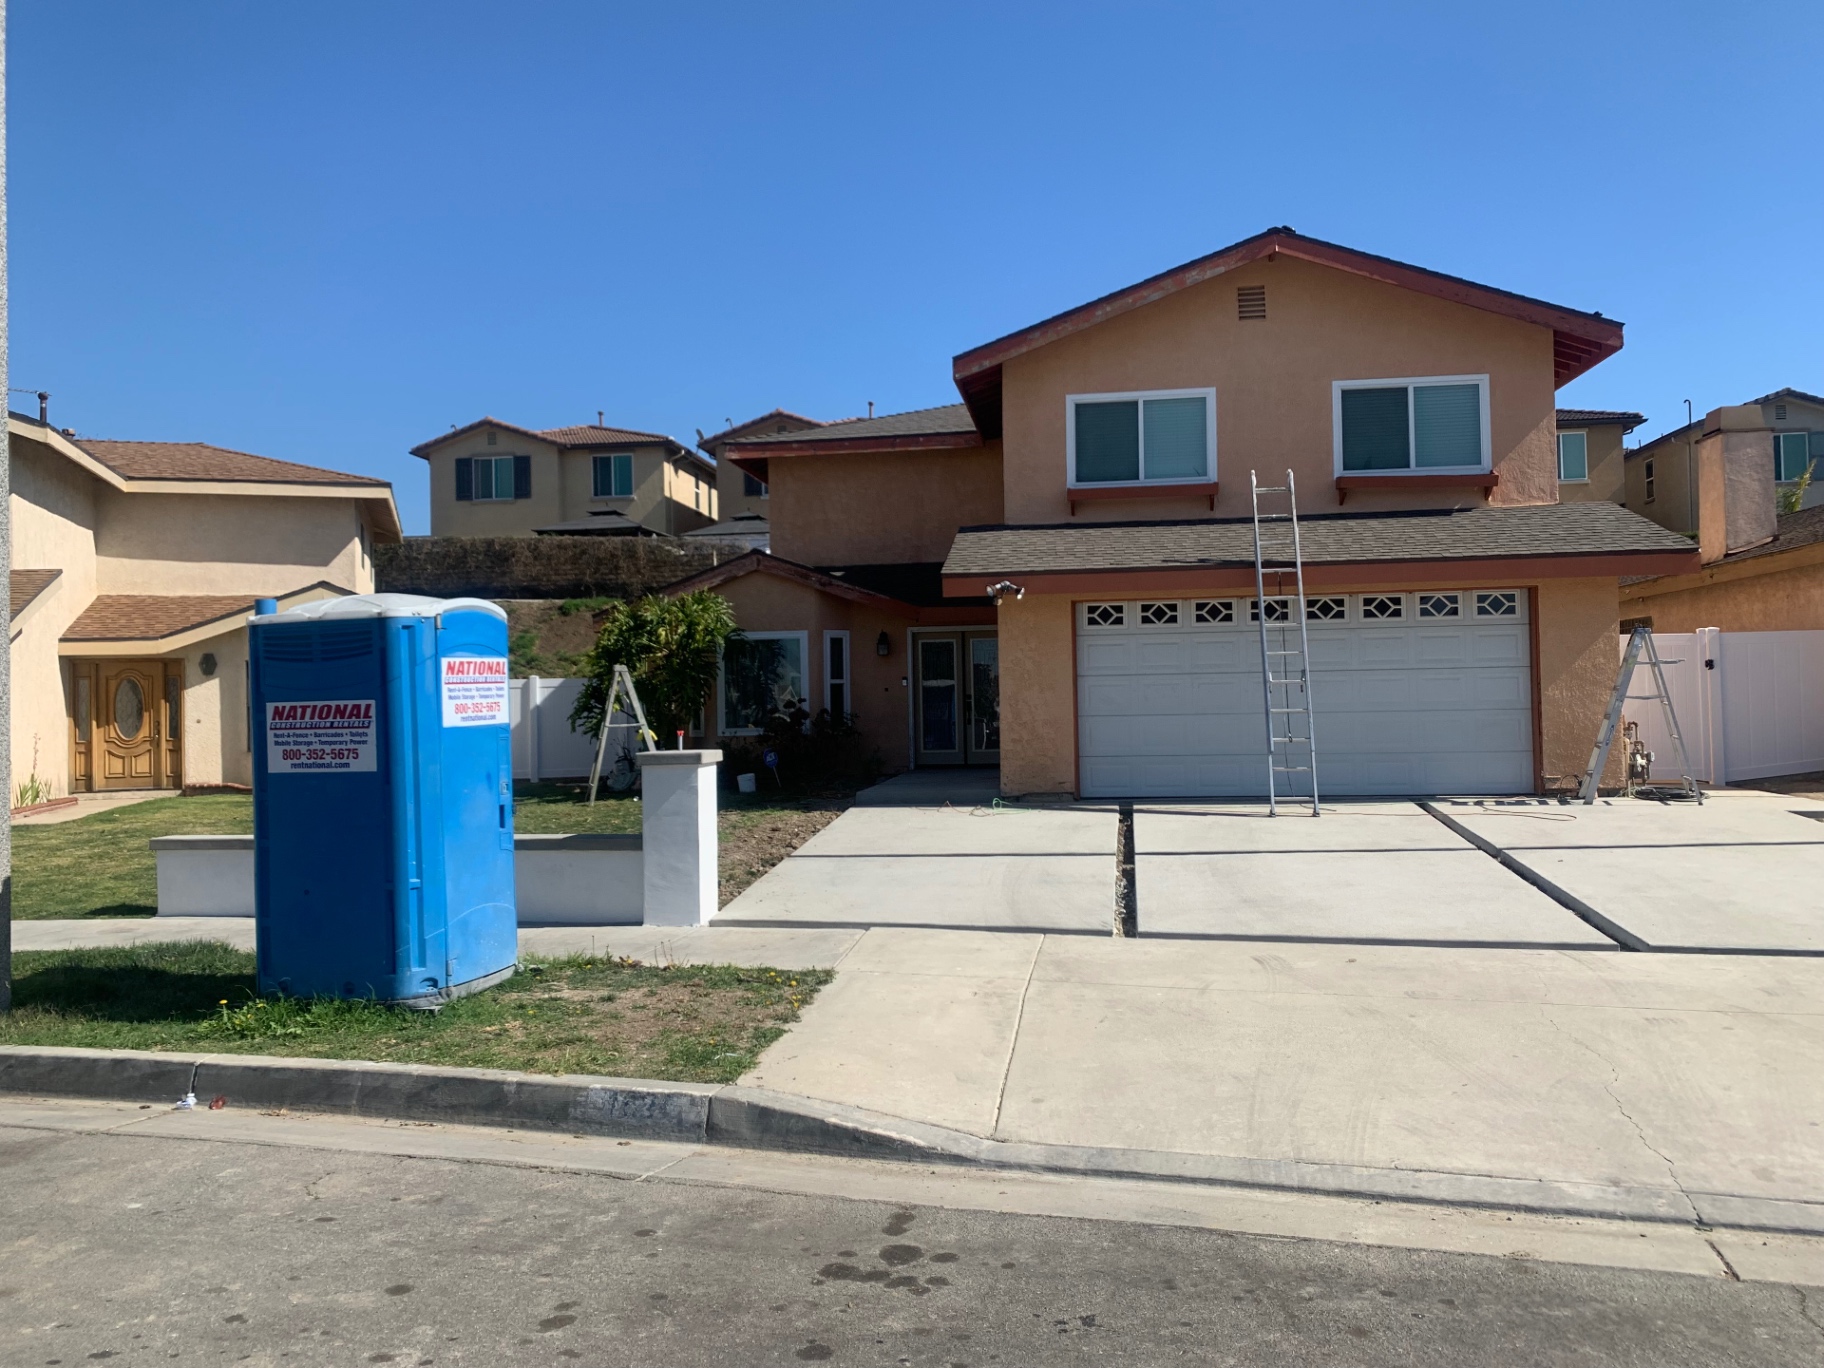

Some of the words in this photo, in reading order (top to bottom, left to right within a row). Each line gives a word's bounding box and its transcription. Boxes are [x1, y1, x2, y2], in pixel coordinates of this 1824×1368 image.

[446, 661, 506, 676] NATIONAL
[271, 704, 372, 721] NATIONAL
[454, 702, 501, 714] 800-352-5675
[270, 721, 332, 729] CONSTRUCTION
[333, 720, 370, 728] RENTALS
[282, 748, 359, 760] 800-352-5675
[290, 761, 351, 769] rentnational.com
